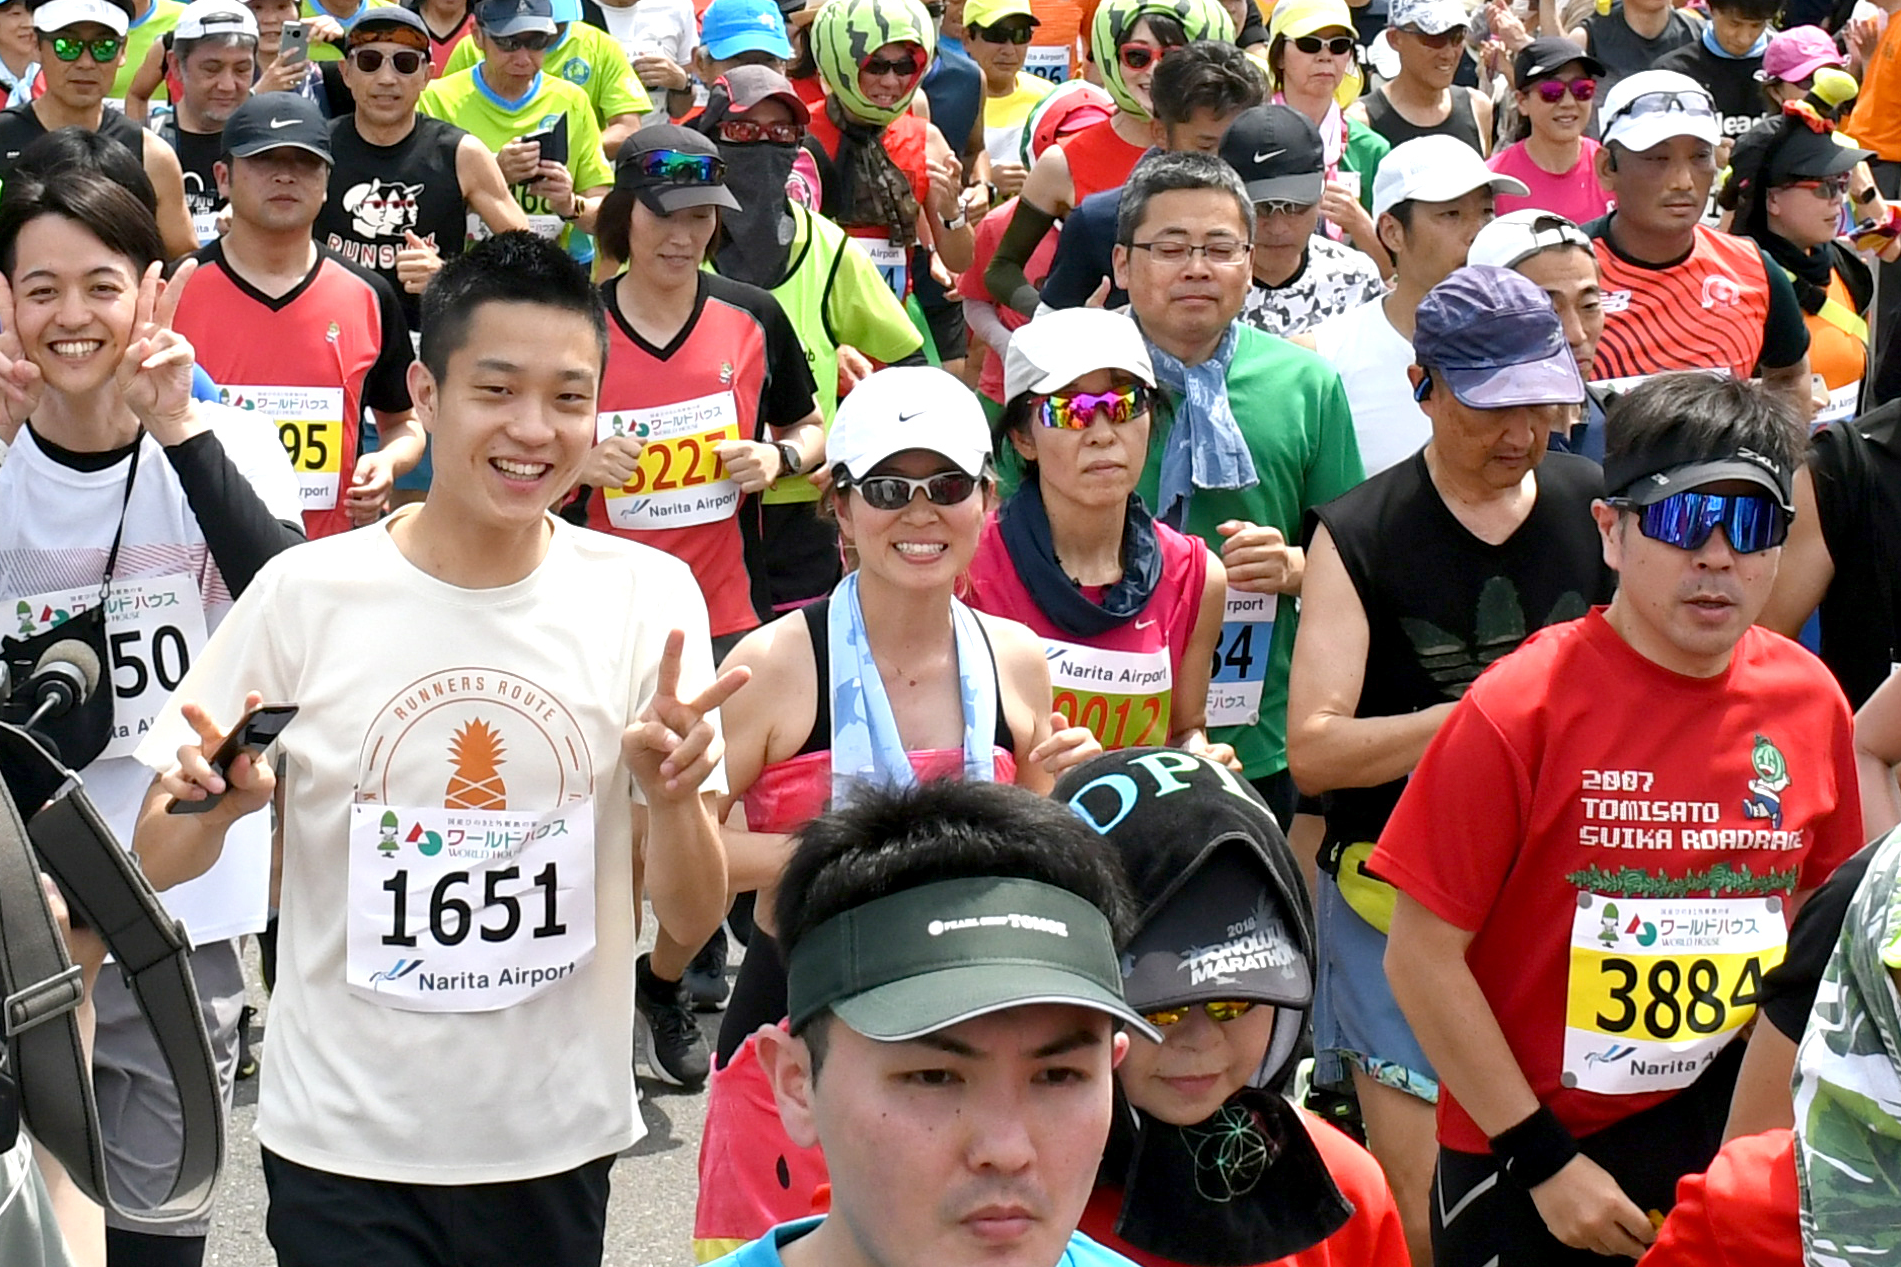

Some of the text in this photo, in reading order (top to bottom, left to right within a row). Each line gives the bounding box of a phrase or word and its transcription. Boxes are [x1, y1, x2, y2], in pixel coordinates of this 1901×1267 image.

[326, 231, 440, 270] RUNSK
[870, 248, 900, 259] Airport
[258, 398, 330, 410] ワールドハウス
[651, 406, 723, 430] ワールドハウス
[278, 422, 328, 470] 95
[649, 491, 737, 518] Narita Airport
[1226, 598, 1265, 614] rport
[109, 624, 191, 700] 50
[1210, 624, 1254, 680] 4
[1059, 659, 1167, 687] Narita Airport
[393, 676, 557, 723] RUNNERS ROUTE
[1580, 769, 1655, 793] 2007
[1580, 797, 1720, 824] TOMISATO
[447, 818, 569, 850] ワールドハウス
[1579, 825, 1673, 851] SUIKA
[448, 848, 489, 859] WORLD
[381, 862, 567, 948] 1651
[1660, 918, 1760, 937] ワールドハウス
[1661, 937, 1721, 947] WORLD HOUSE
[419, 961, 575, 991] Narita Airport
[1190, 940, 1296, 987] MARATHON
[1596, 957, 1763, 1040] 3884
[1630, 1059, 1696, 1076] Narita
